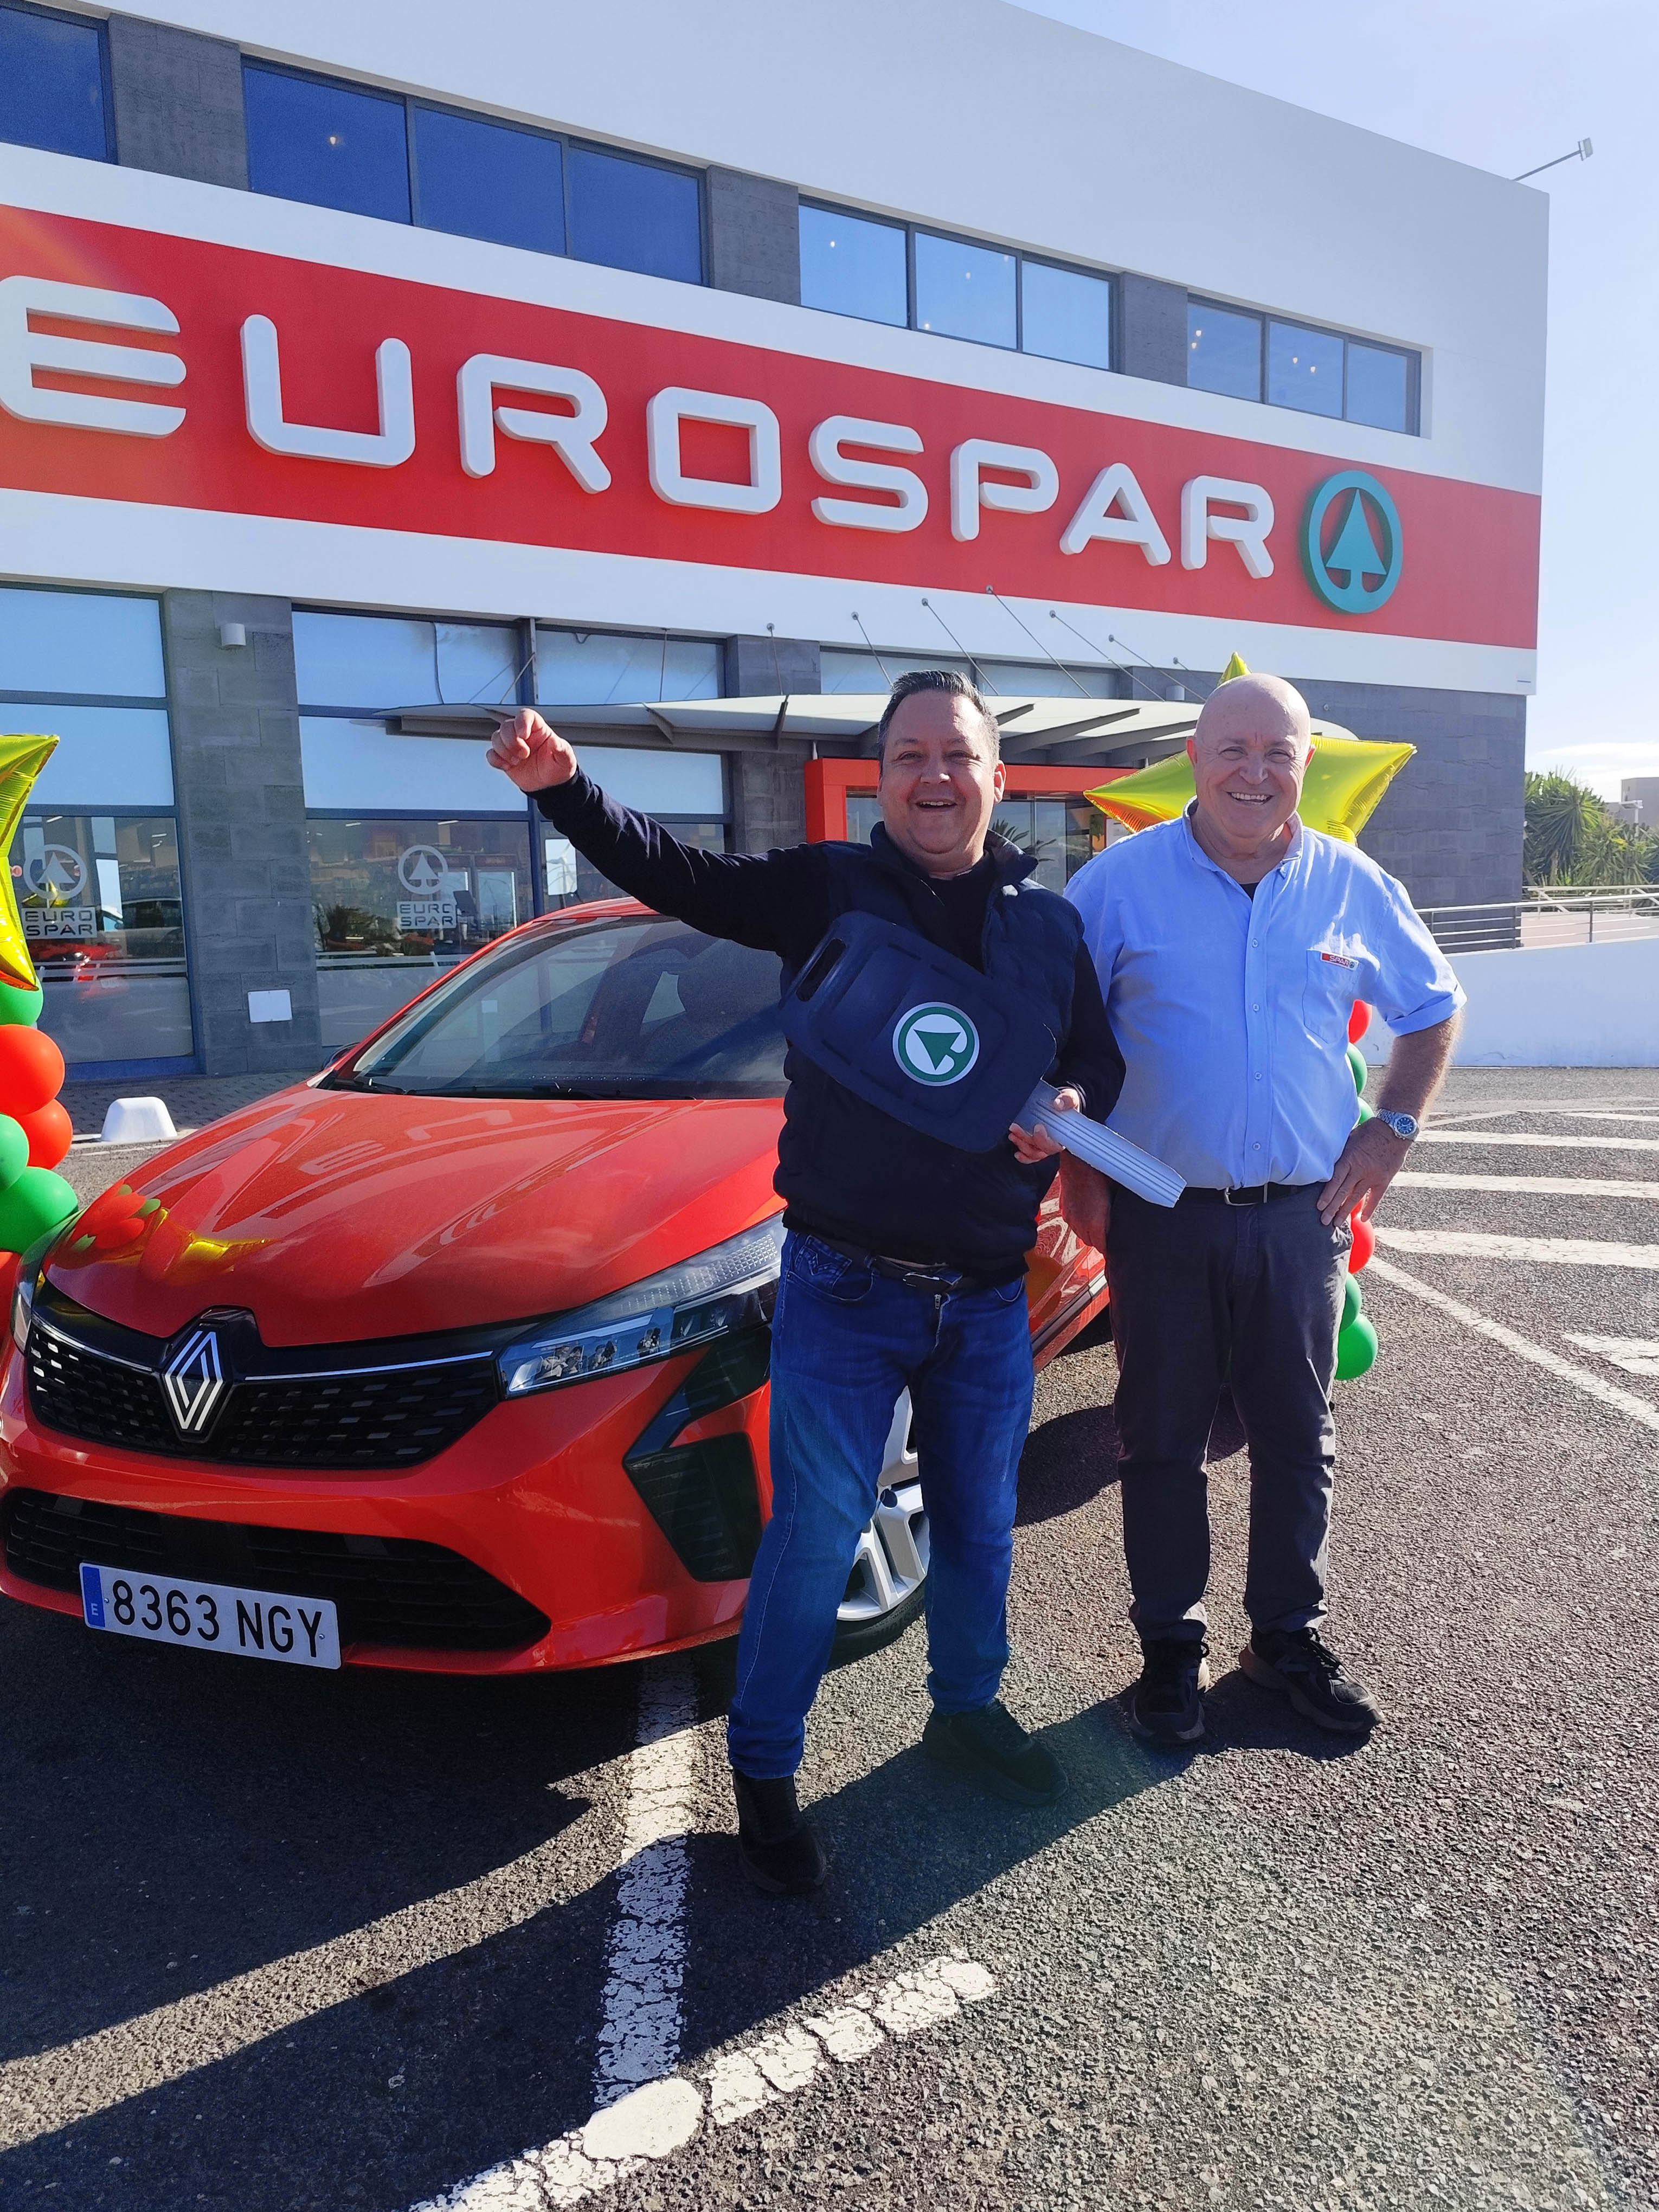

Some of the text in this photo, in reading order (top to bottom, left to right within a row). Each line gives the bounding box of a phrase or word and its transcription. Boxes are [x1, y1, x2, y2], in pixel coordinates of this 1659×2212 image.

[0, 275, 1275, 580] EUROSPAR
[399, 903, 453, 914] EURO
[24, 910, 93, 922] EURO
[400, 916, 453, 927] SPAR
[26, 924, 93, 936] SPAR
[1329, 955, 1349, 966] SPAR
[91, 1603, 99, 1616] E
[112, 1580, 322, 1658] 8363 NGY
